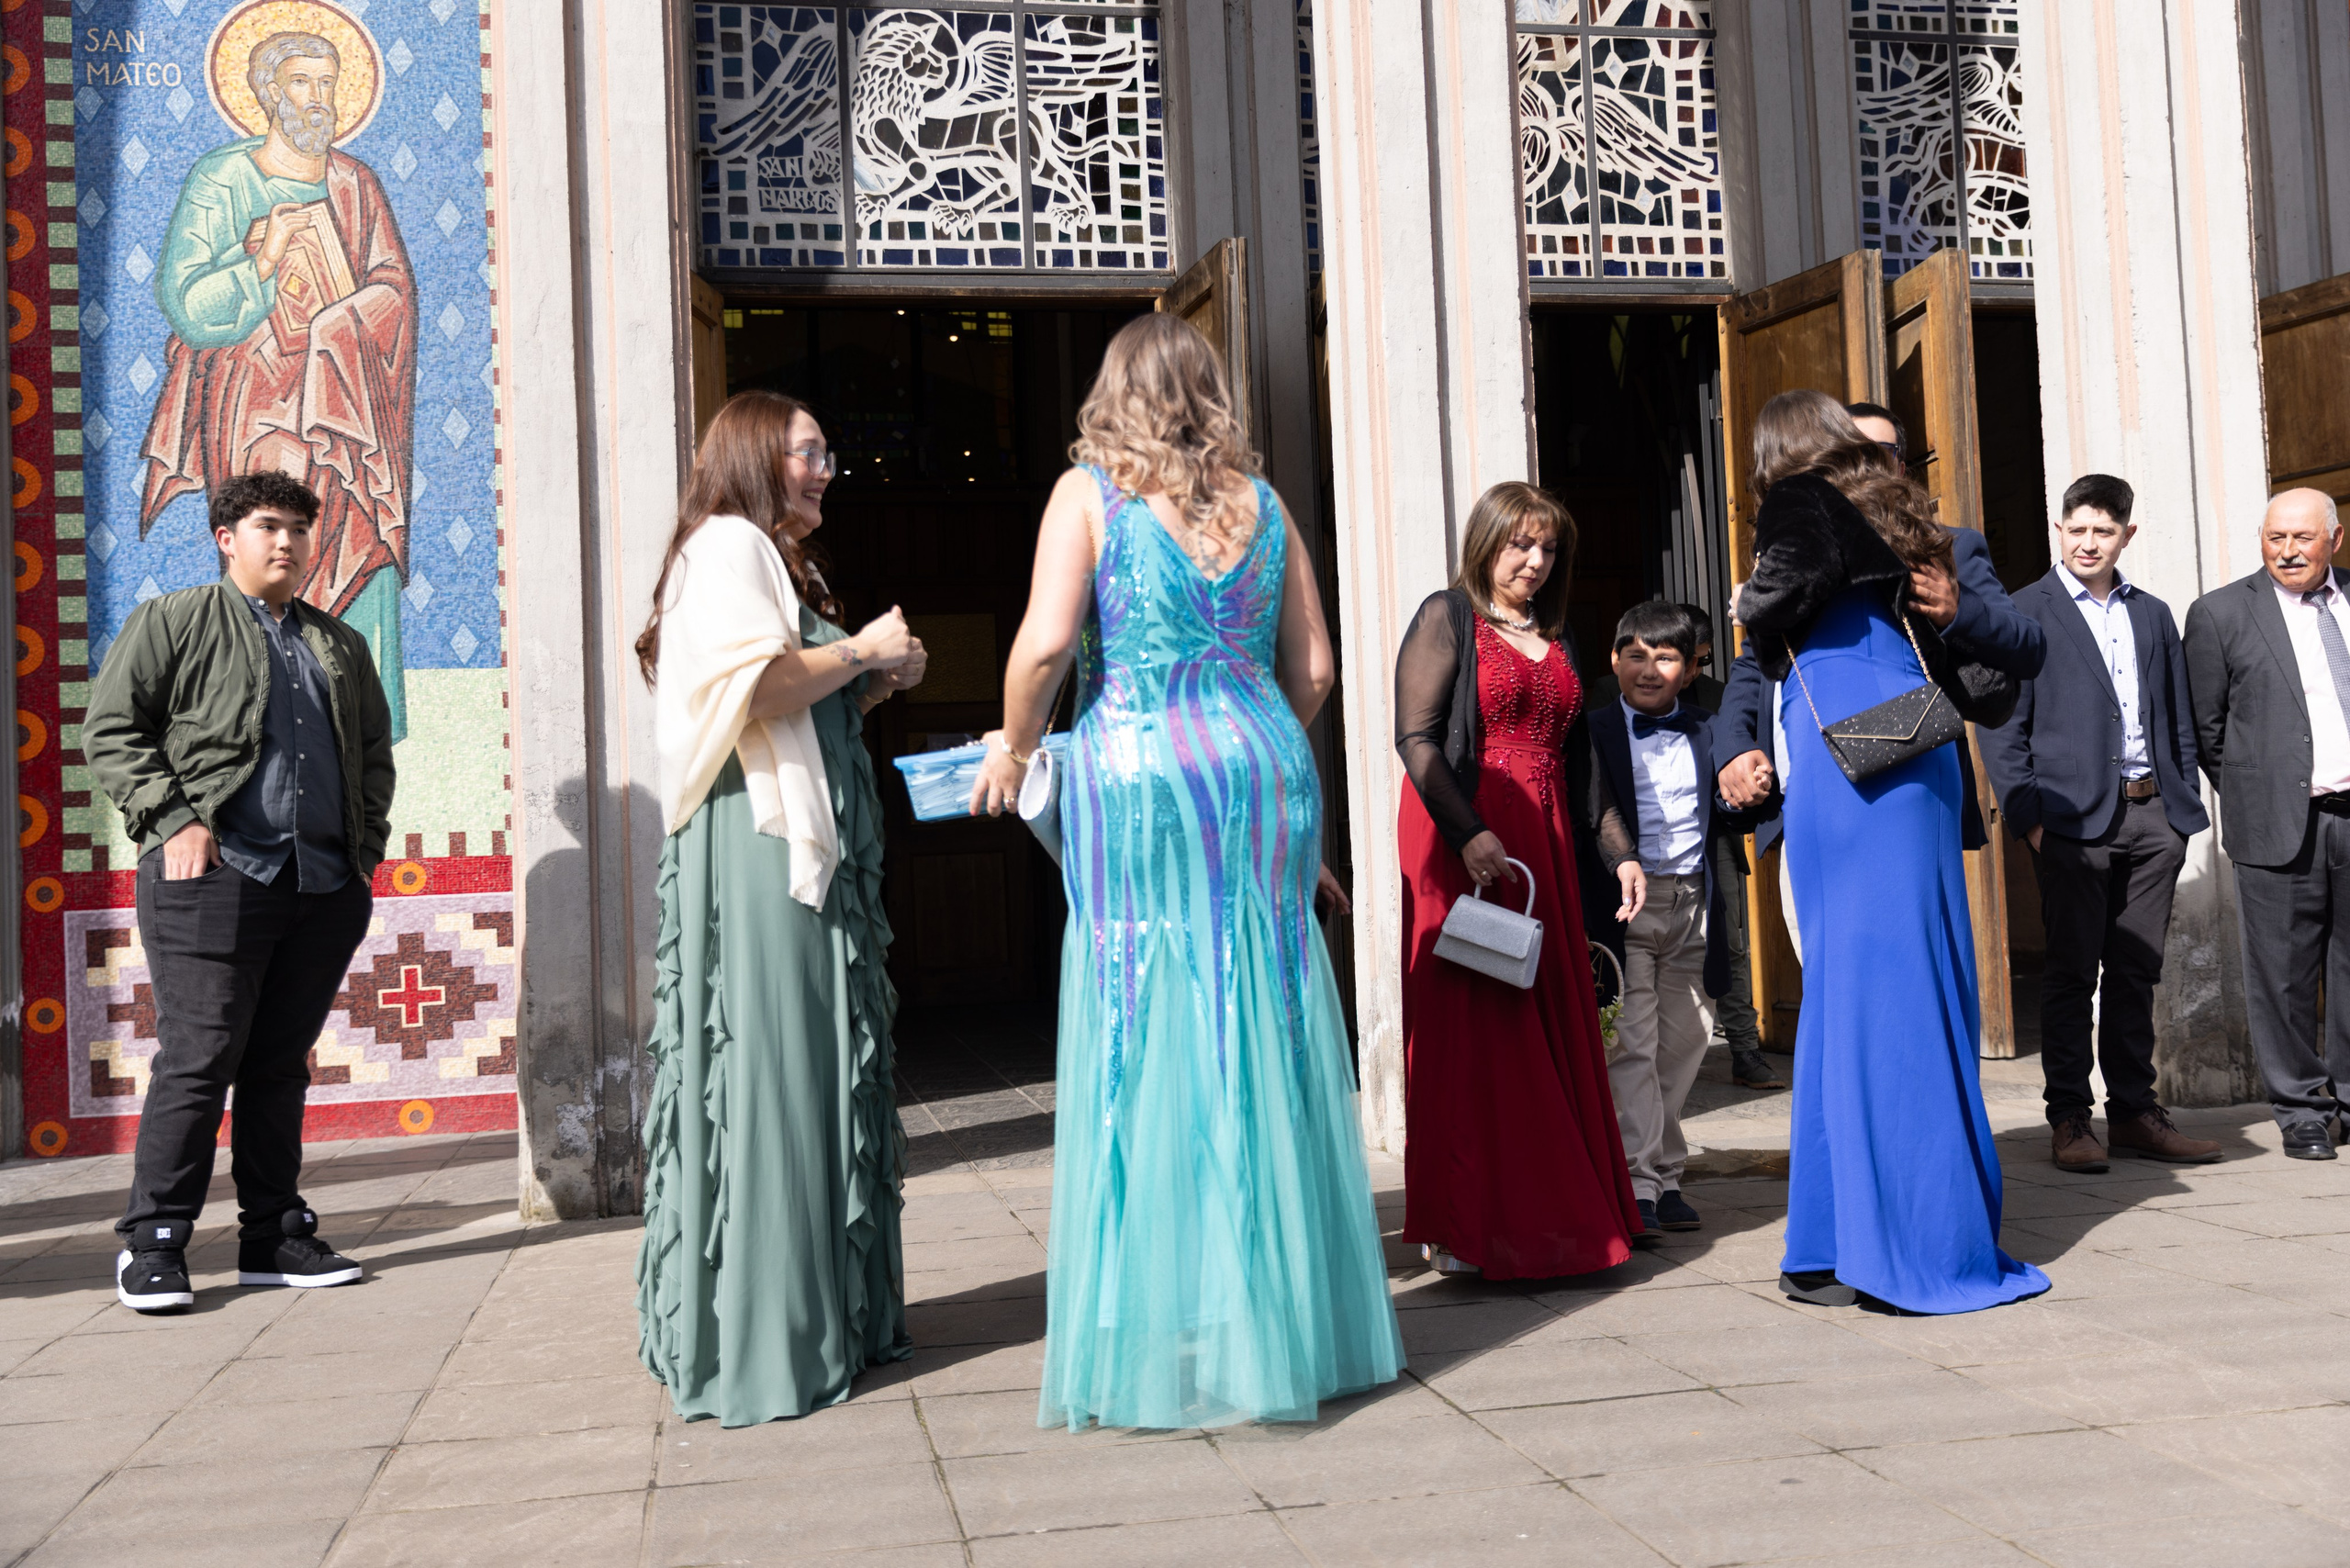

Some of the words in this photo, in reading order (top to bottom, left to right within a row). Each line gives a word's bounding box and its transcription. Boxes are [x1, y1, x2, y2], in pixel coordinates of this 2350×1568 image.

[84, 28, 145, 52] SAN
[86, 62, 182, 87] MATEO
[758, 157, 801, 178] SAN
[760, 189, 836, 212] MARCOS
